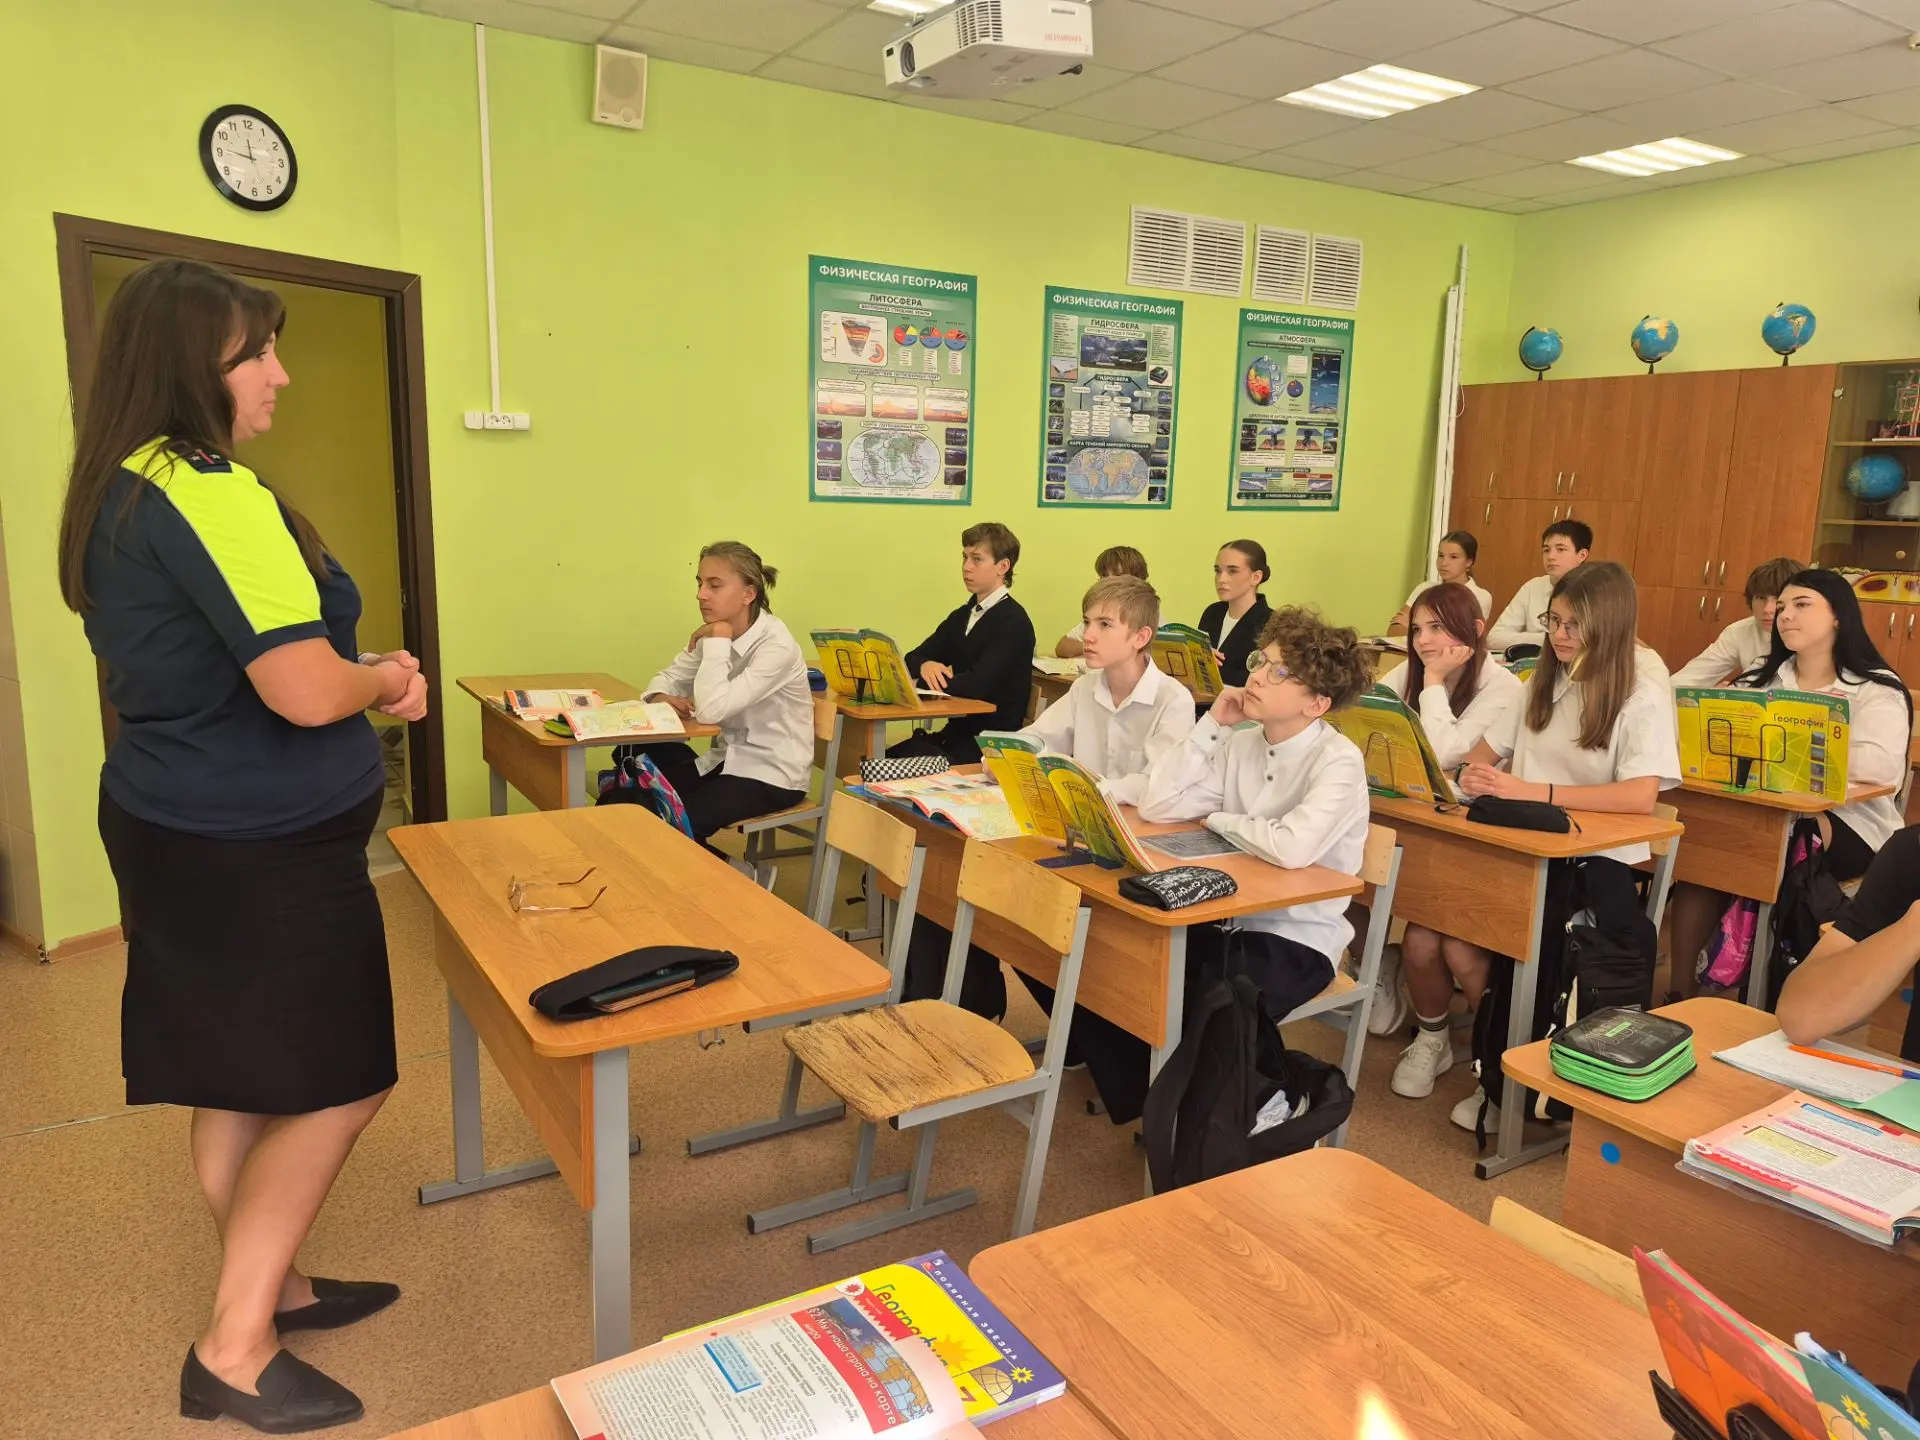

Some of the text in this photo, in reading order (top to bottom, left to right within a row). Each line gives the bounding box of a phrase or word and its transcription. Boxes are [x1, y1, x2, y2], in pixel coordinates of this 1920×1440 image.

[228, 121, 237, 131] 11
[242, 120, 253, 130] 12
[217, 131, 228, 141] 10
[261, 128, 265, 137] 1
[272, 141, 279, 151] 2
[216, 147, 223, 157] 9
[278, 158, 285, 168] 3
[223, 166, 230, 176] 8
[236, 180, 242, 189] 7
[275, 176, 281, 184] 4
[251, 187, 258, 197] 6
[266, 185, 273, 195] 5
[819, 264, 968, 293] ФИЗИЧЕСКАЯ ГЕОГРАФИЯ
[869, 294, 923, 307] ЛИТОСФЕРА
[1053, 294, 1176, 315] ФИЗИЧЕСКАЯ ГЕОГРАФИЯ
[1091, 319, 1139, 330] ГИДРОСФЕРА
[1246, 312, 1349, 330] ФИЗИЧЕСКАЯ ГЕОГРАФИЯ
[1279, 335, 1316, 344] АТМОСФЕРА
[1774, 713, 1824, 729] География
[1833, 725, 1842, 739] 8
[934, 1270, 1018, 1360] ПОЛЯРНАЯ ЗВЕЗДА
[803, 1323, 821, 1340] мира
[816, 1317, 829, 1332] Мы
[832, 1332, 848, 1352] наша
[845, 1351, 869, 1377] страна
[866, 1375, 878, 1389] на
[874, 1386, 896, 1425] карте
